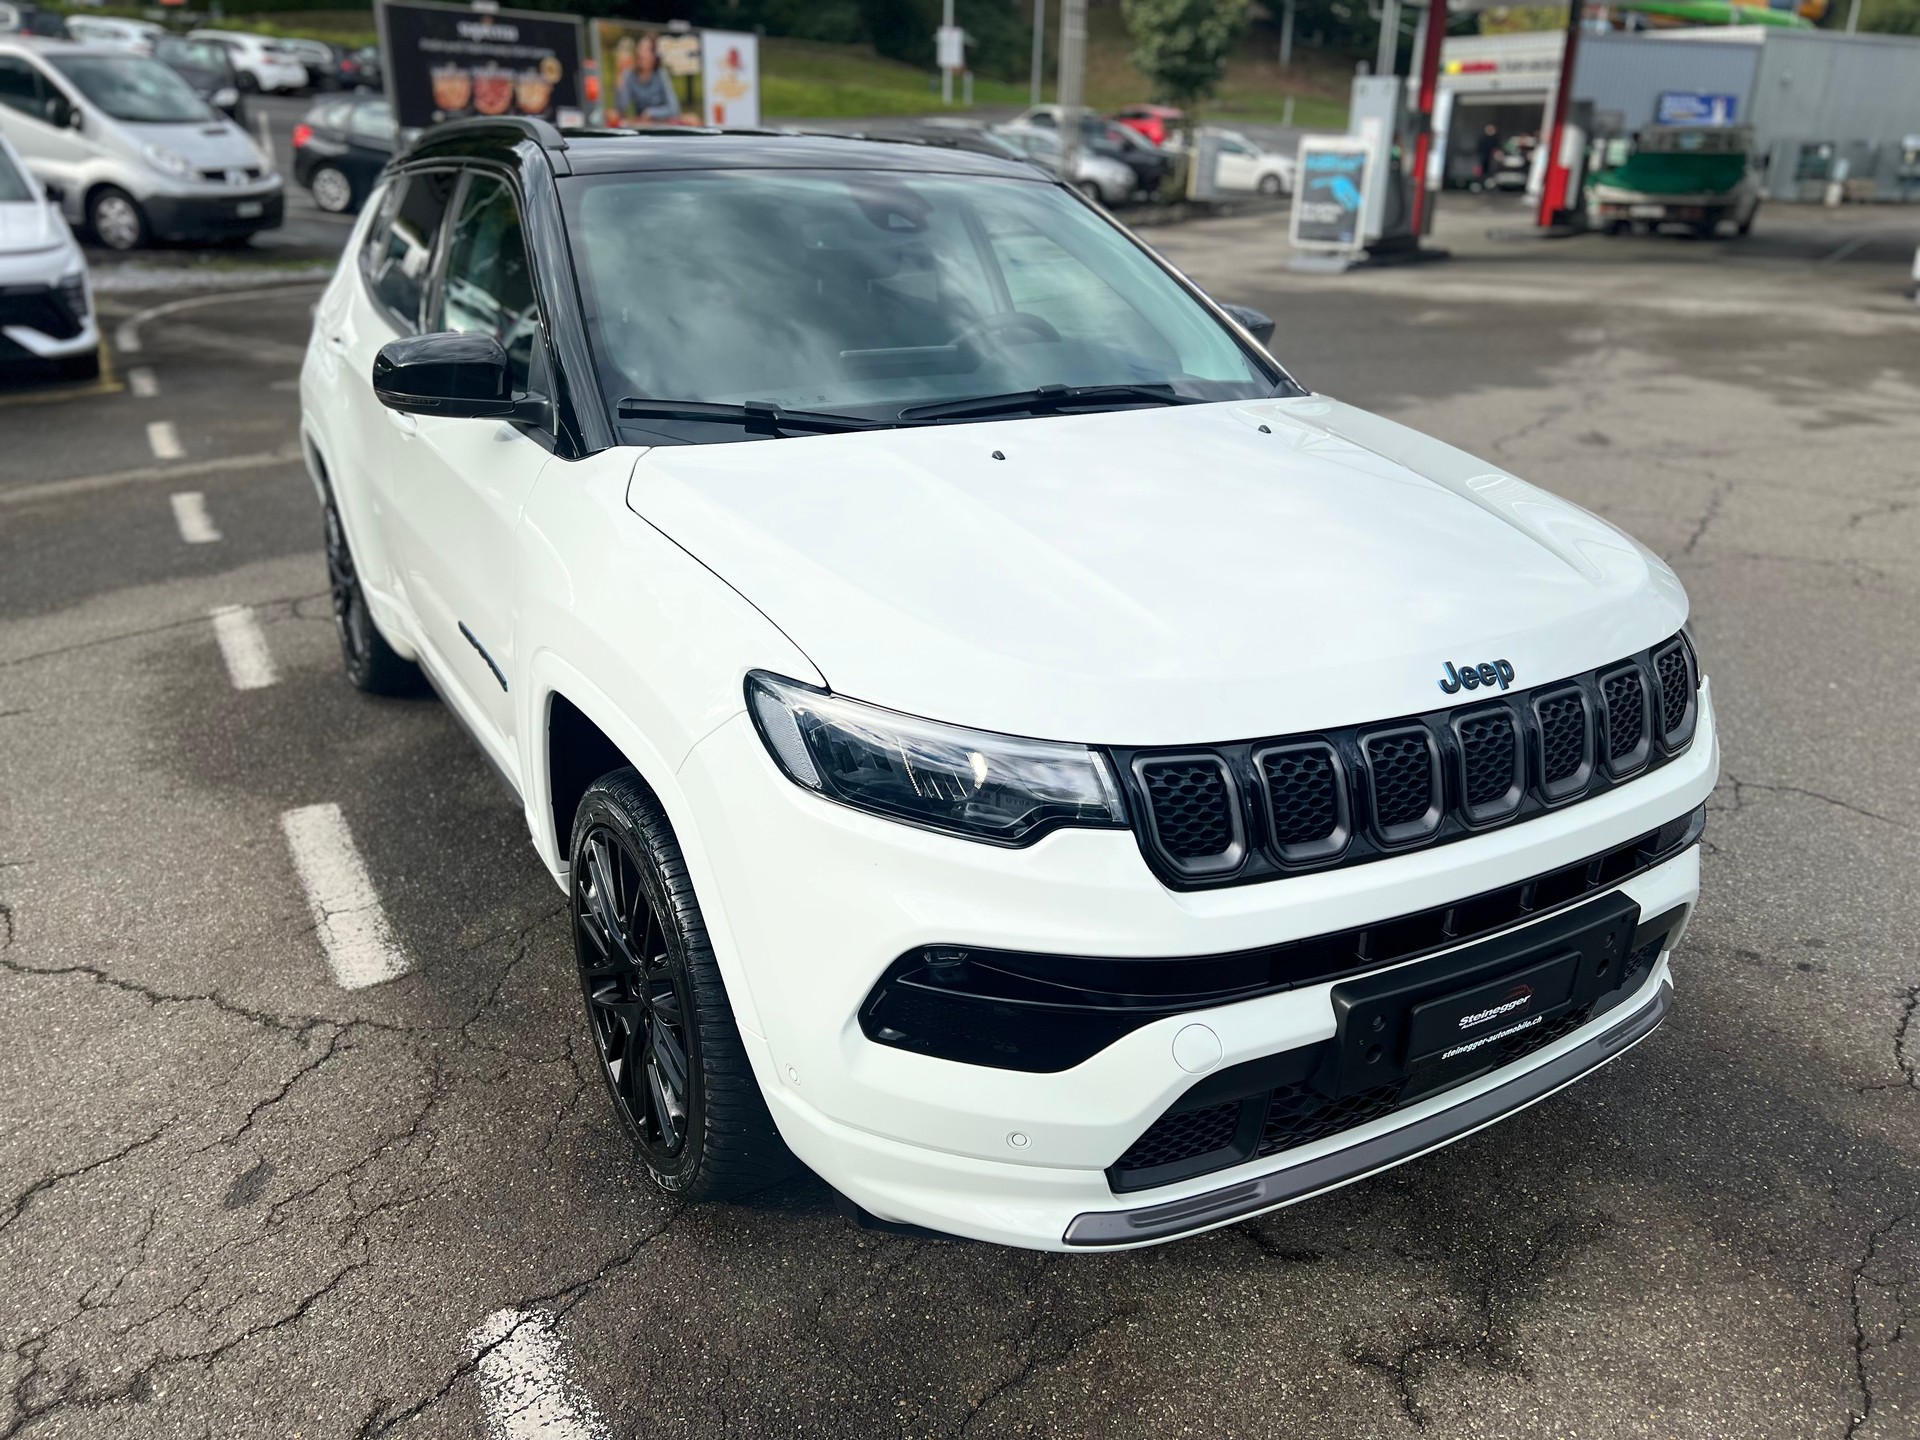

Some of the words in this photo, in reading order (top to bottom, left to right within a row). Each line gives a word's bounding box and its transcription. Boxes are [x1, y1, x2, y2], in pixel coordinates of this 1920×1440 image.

[1438, 659, 1515, 694] Jeep
[1459, 995, 1531, 1026] Steinegger
[1442, 1015, 1543, 1060] steinegger-automobile.ch
